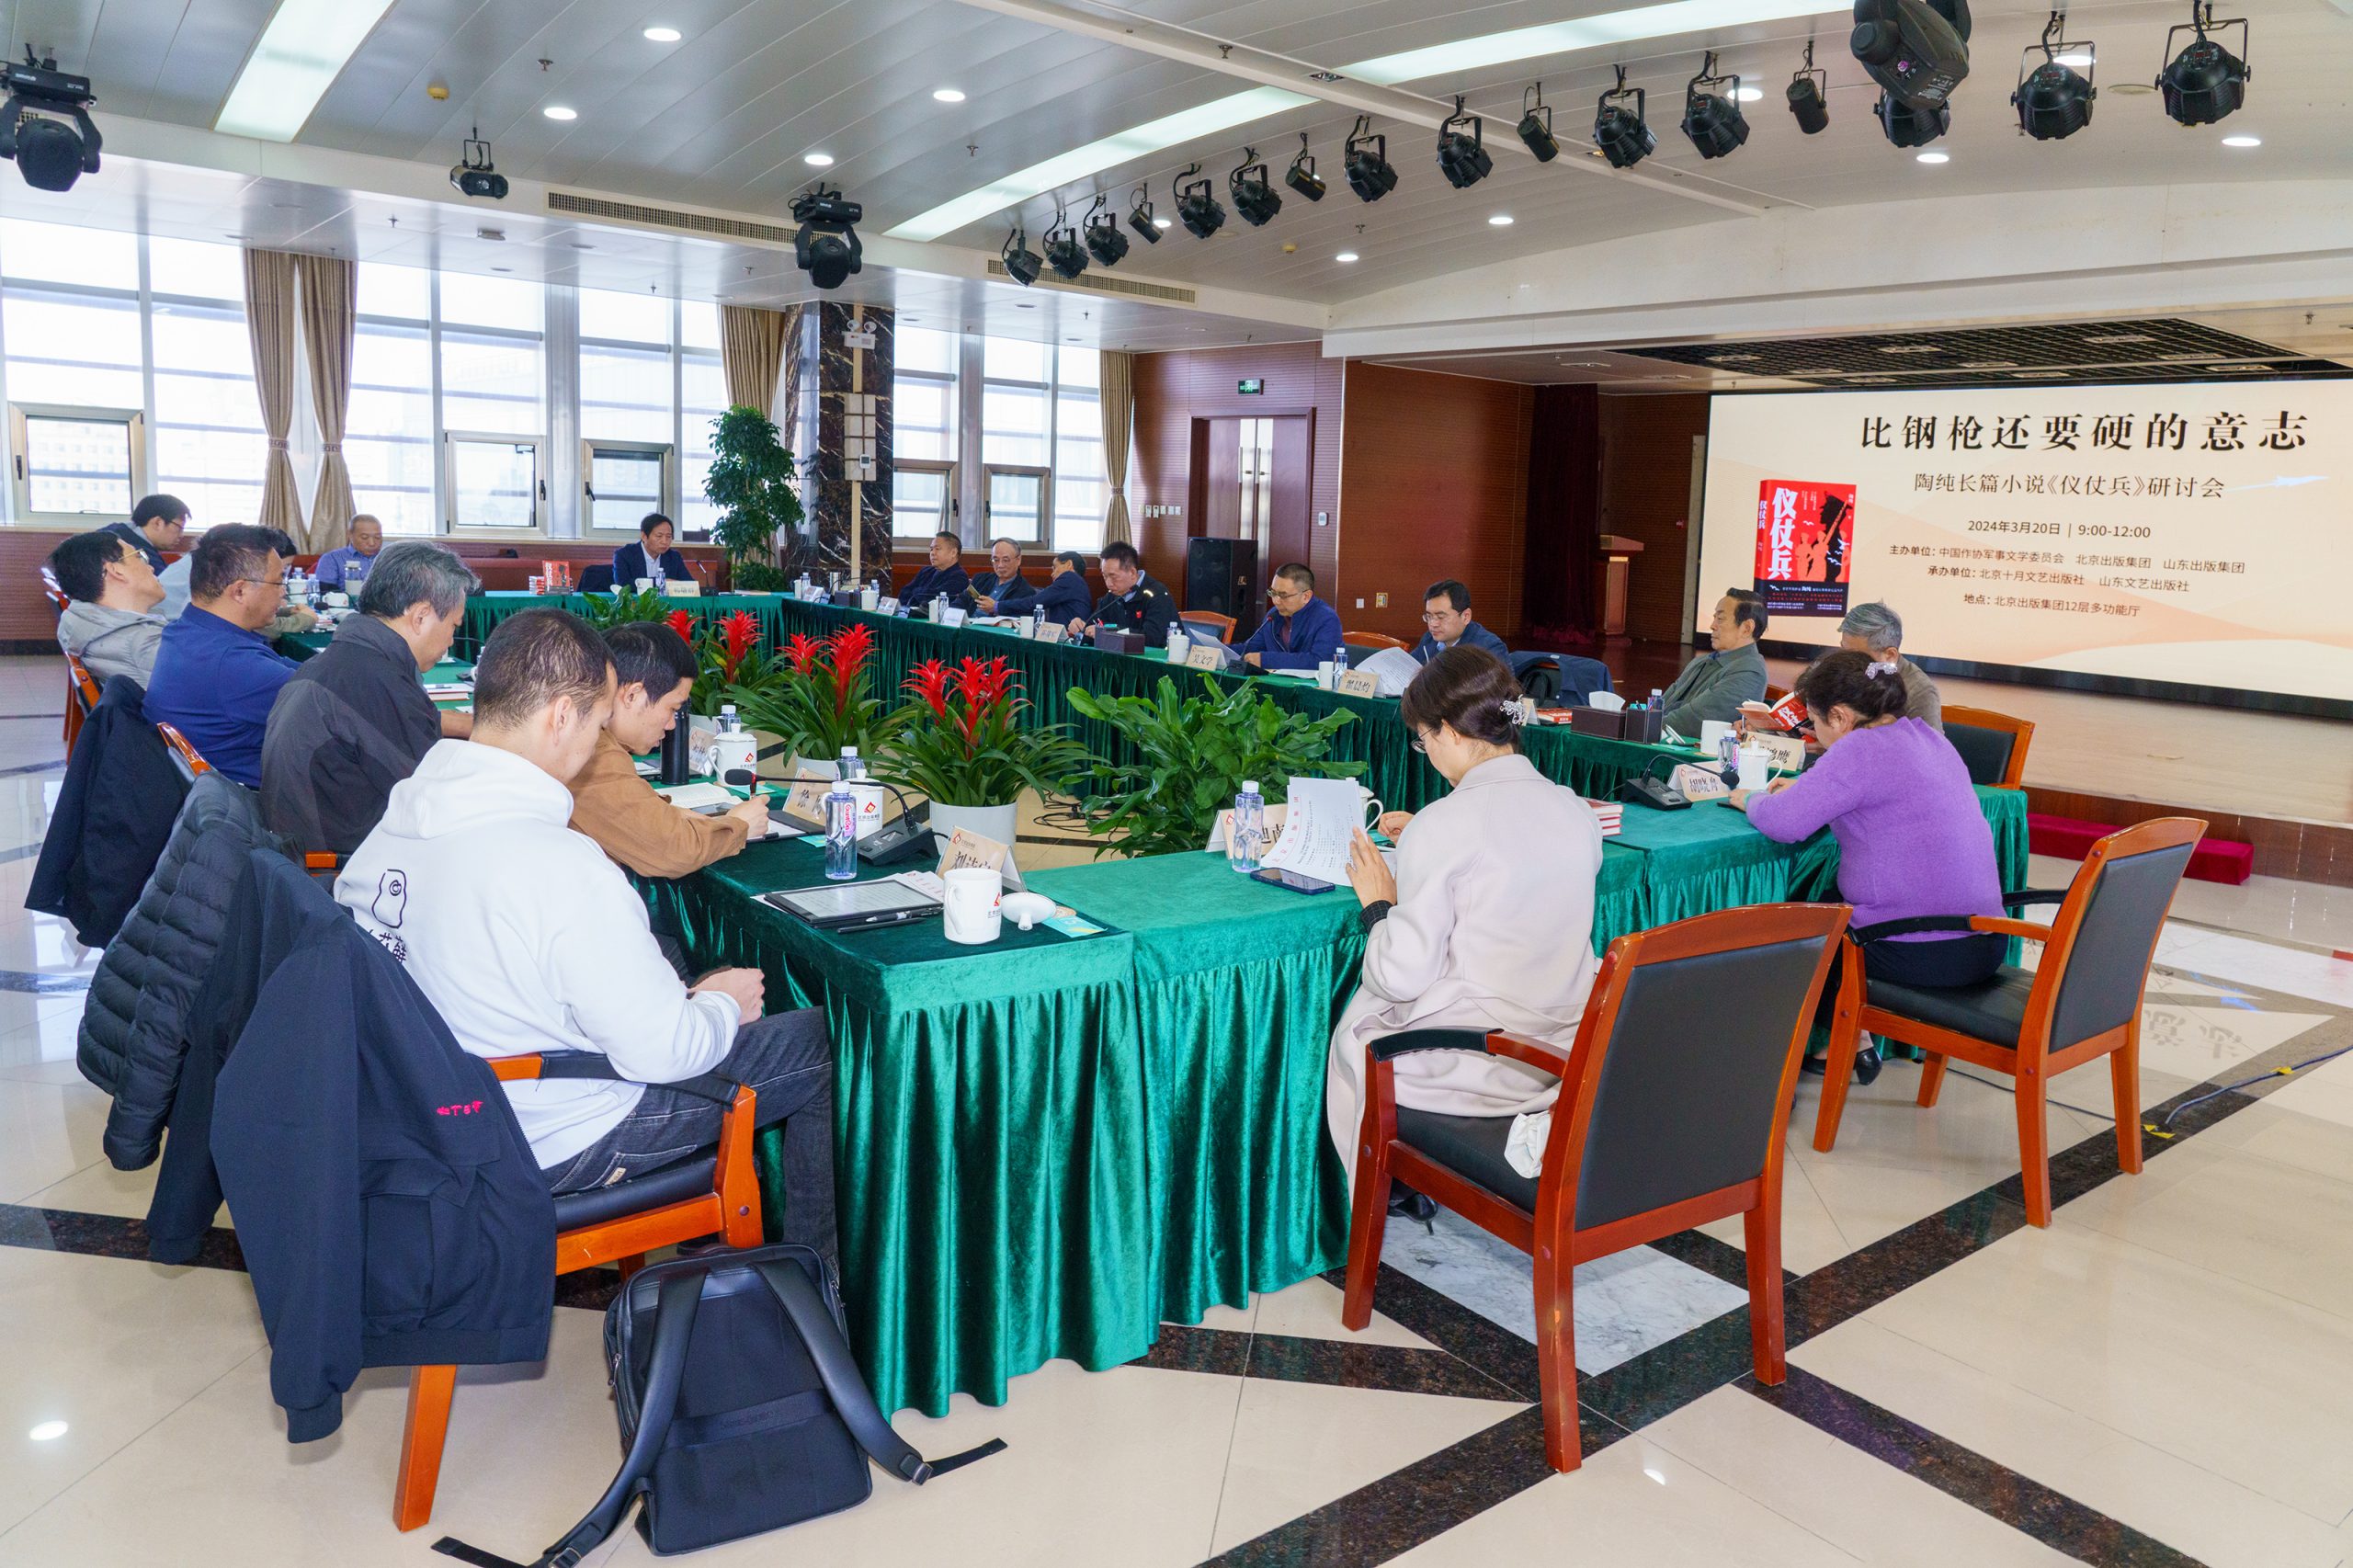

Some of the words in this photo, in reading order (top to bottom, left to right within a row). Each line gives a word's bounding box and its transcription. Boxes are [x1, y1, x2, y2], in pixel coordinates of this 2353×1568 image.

[1861, 411, 2308, 451] 比钢枪还要硬的意志
[1914, 473, 2224, 498] 陶纯长篇小说《仪仗兵》研讨会
[1768, 487, 1799, 580] 仪仗兵
[1968, 520, 2060, 535] 2024年3月20日
[2078, 524, 2151, 538] 9:00-12:00
[2075, 553, 2151, 569] 北京出版集团
[2163, 558, 2245, 574] 山东出版集团
[2099, 575, 2189, 592] 山东文艺出版社
